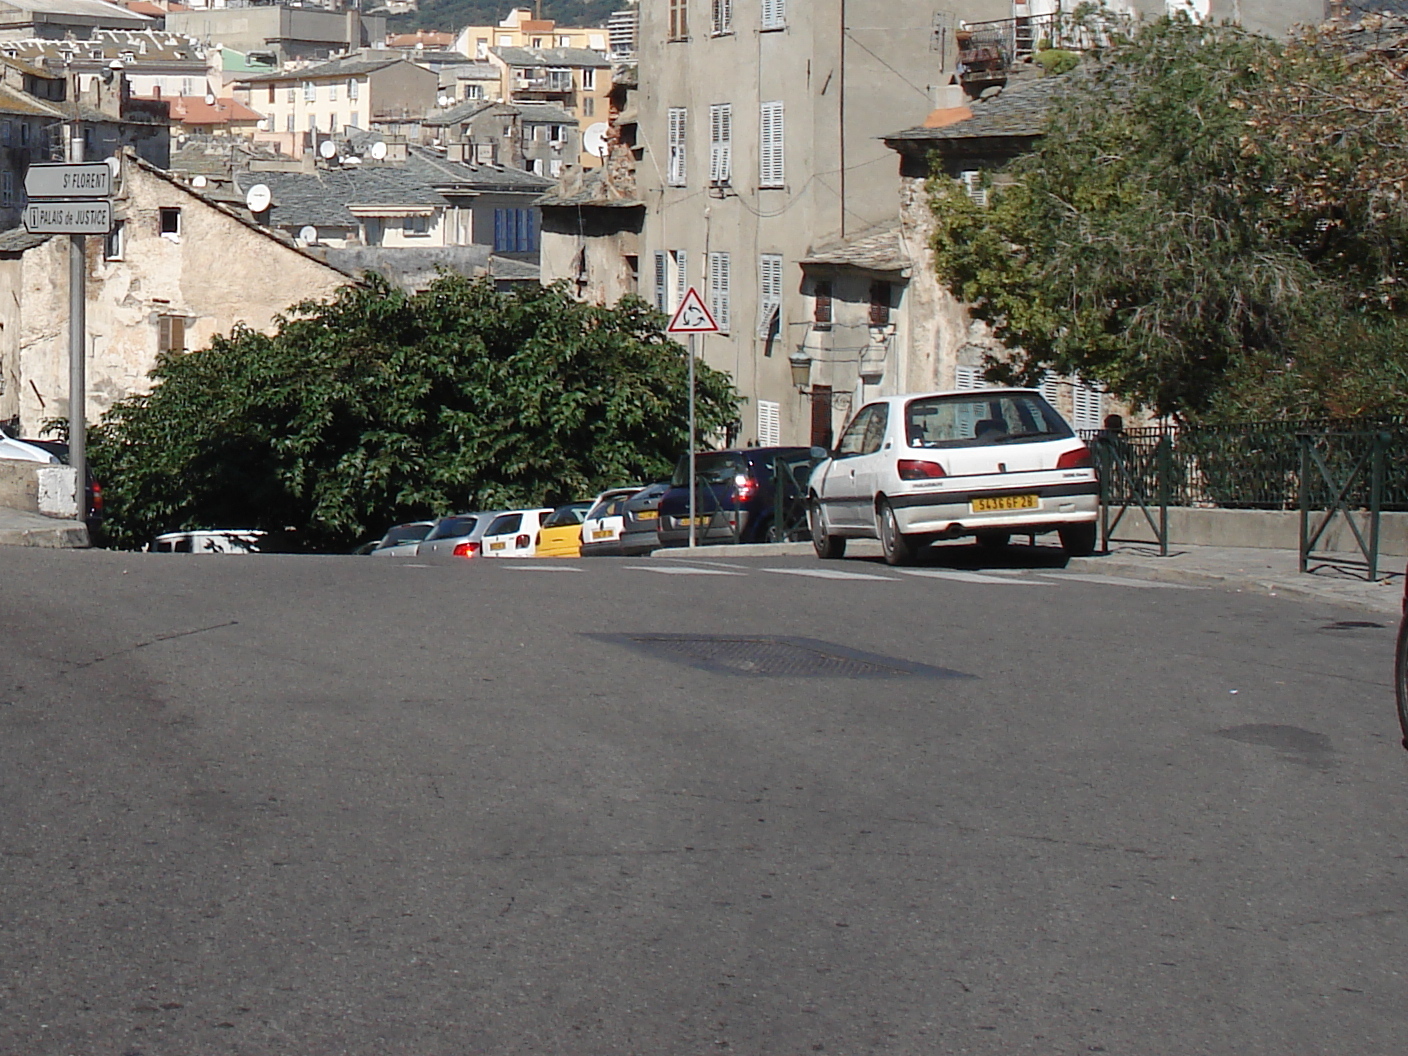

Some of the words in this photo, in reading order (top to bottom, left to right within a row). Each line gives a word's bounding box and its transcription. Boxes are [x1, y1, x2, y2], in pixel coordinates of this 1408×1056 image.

[72, 172, 106, 189] FLORENT
[40, 209, 64, 225] PALAIS
[65, 211, 73, 226] de
[75, 209, 107, 225] JUSTICE
[979, 498, 1004, 510] 5436
